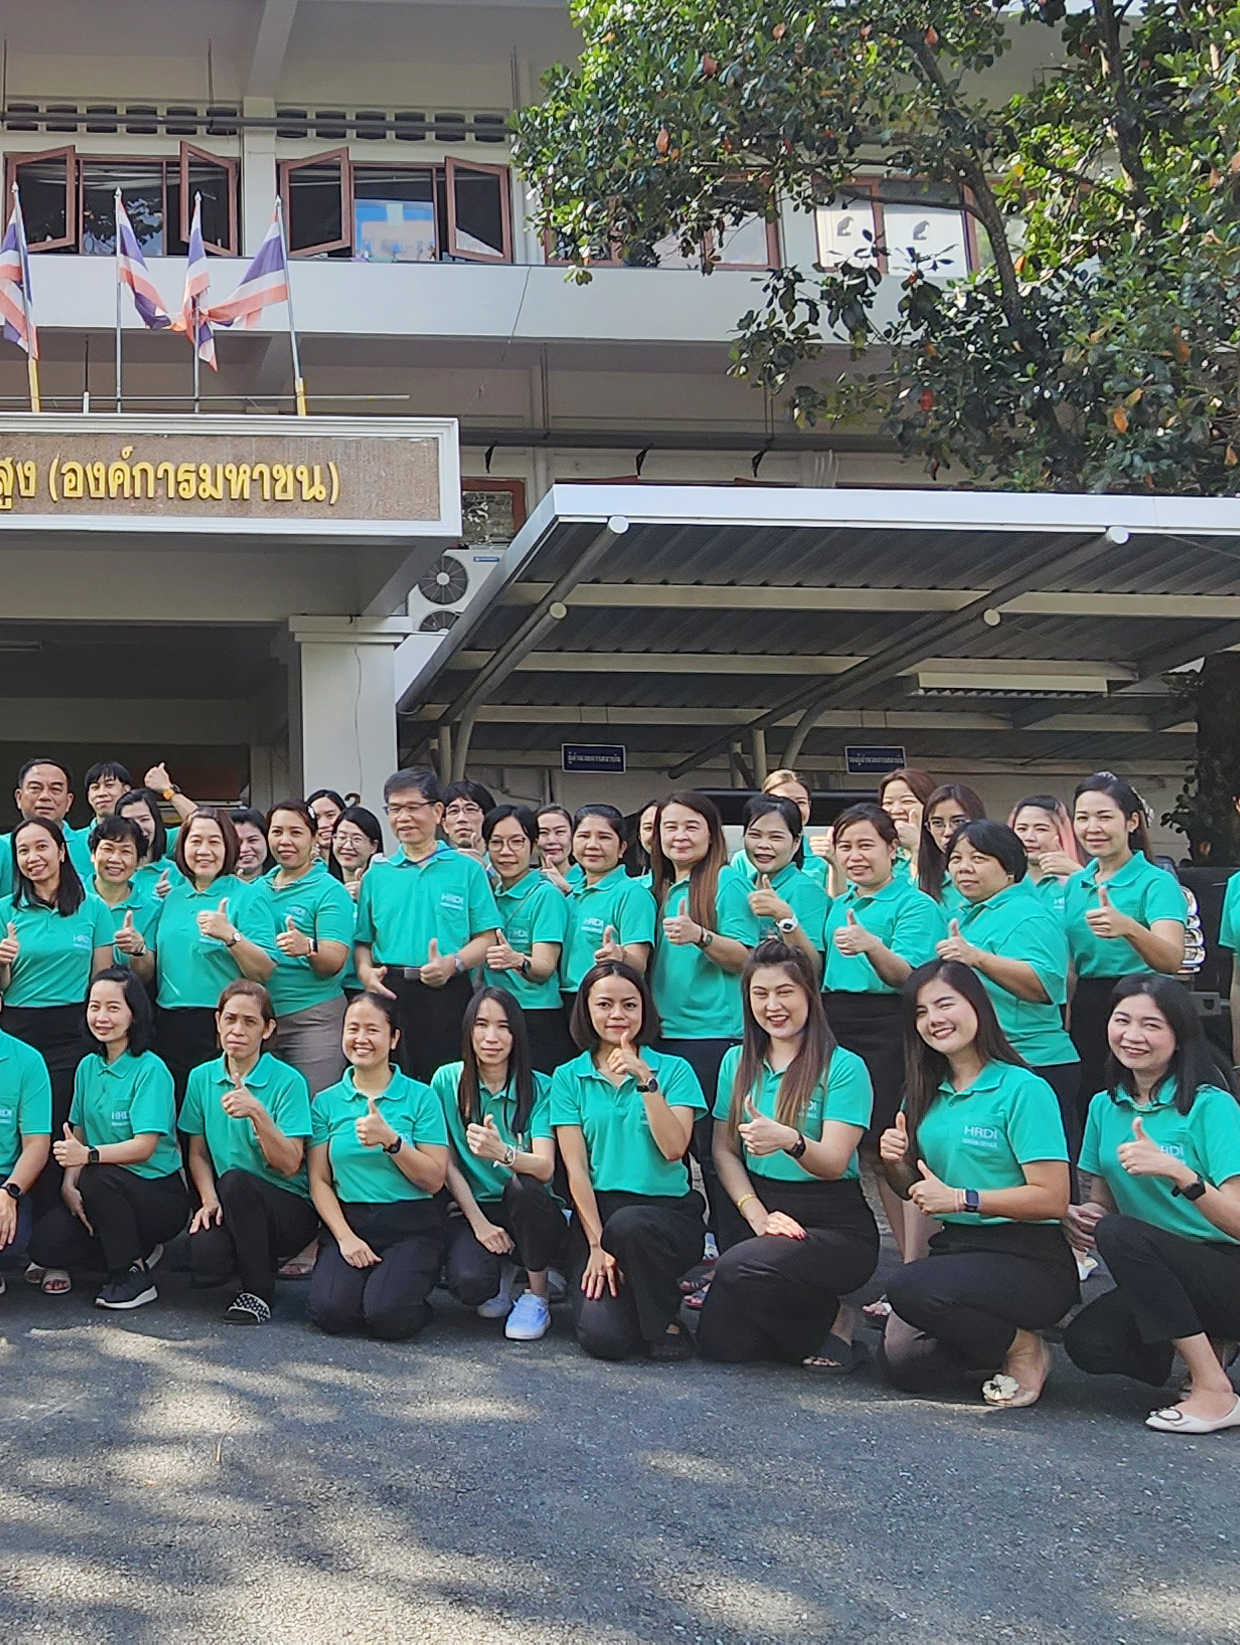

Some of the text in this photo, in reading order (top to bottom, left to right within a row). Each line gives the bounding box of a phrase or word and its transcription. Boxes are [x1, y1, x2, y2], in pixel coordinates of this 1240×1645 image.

[48, 445, 340, 504] (องค์การมหาชน)
[111, 1110, 129, 1120] HRD
[964, 1126, 997, 1139] HRDI
